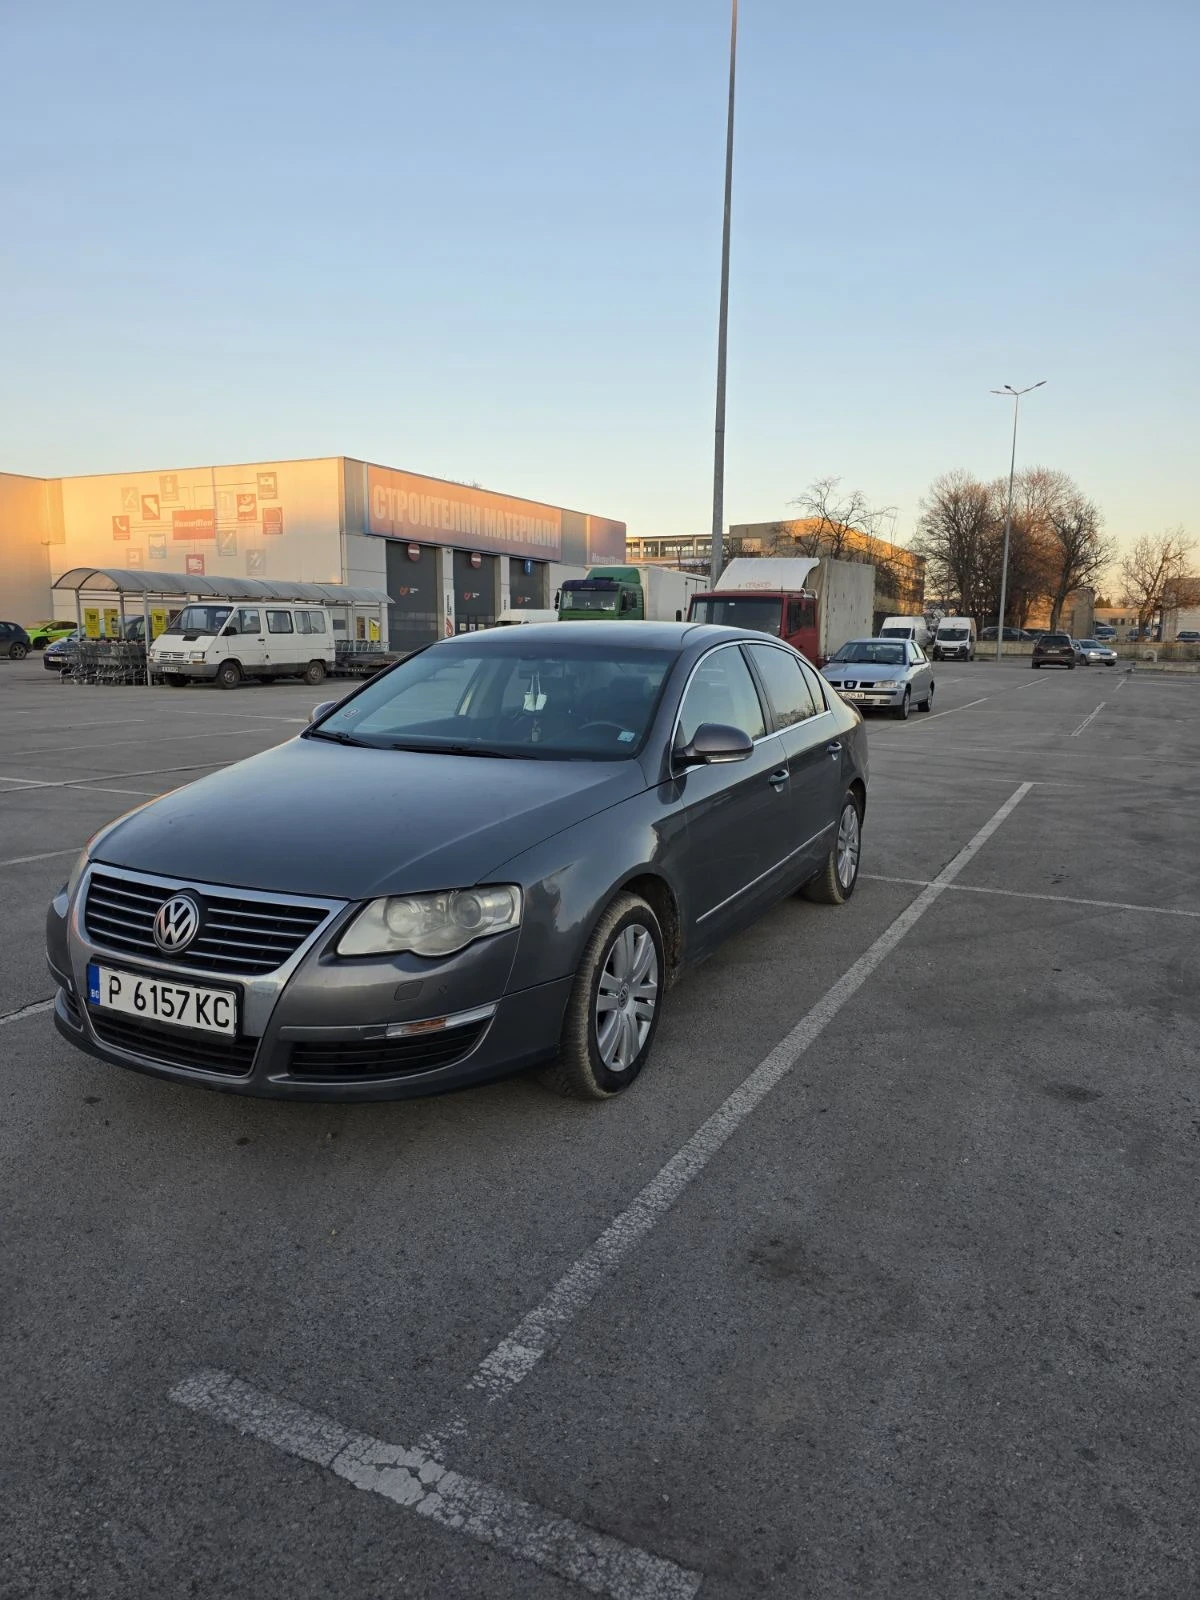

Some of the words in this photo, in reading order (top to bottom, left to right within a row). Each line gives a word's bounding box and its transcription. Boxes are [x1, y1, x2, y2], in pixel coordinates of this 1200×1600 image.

[373, 485, 481, 534] СТРОИТЕЛНИ
[484, 508, 559, 548] МАТЕРИАЛИ
[108, 974, 122, 1004] P
[133, 981, 190, 1020] 6157
[195, 992, 230, 1028] KC
